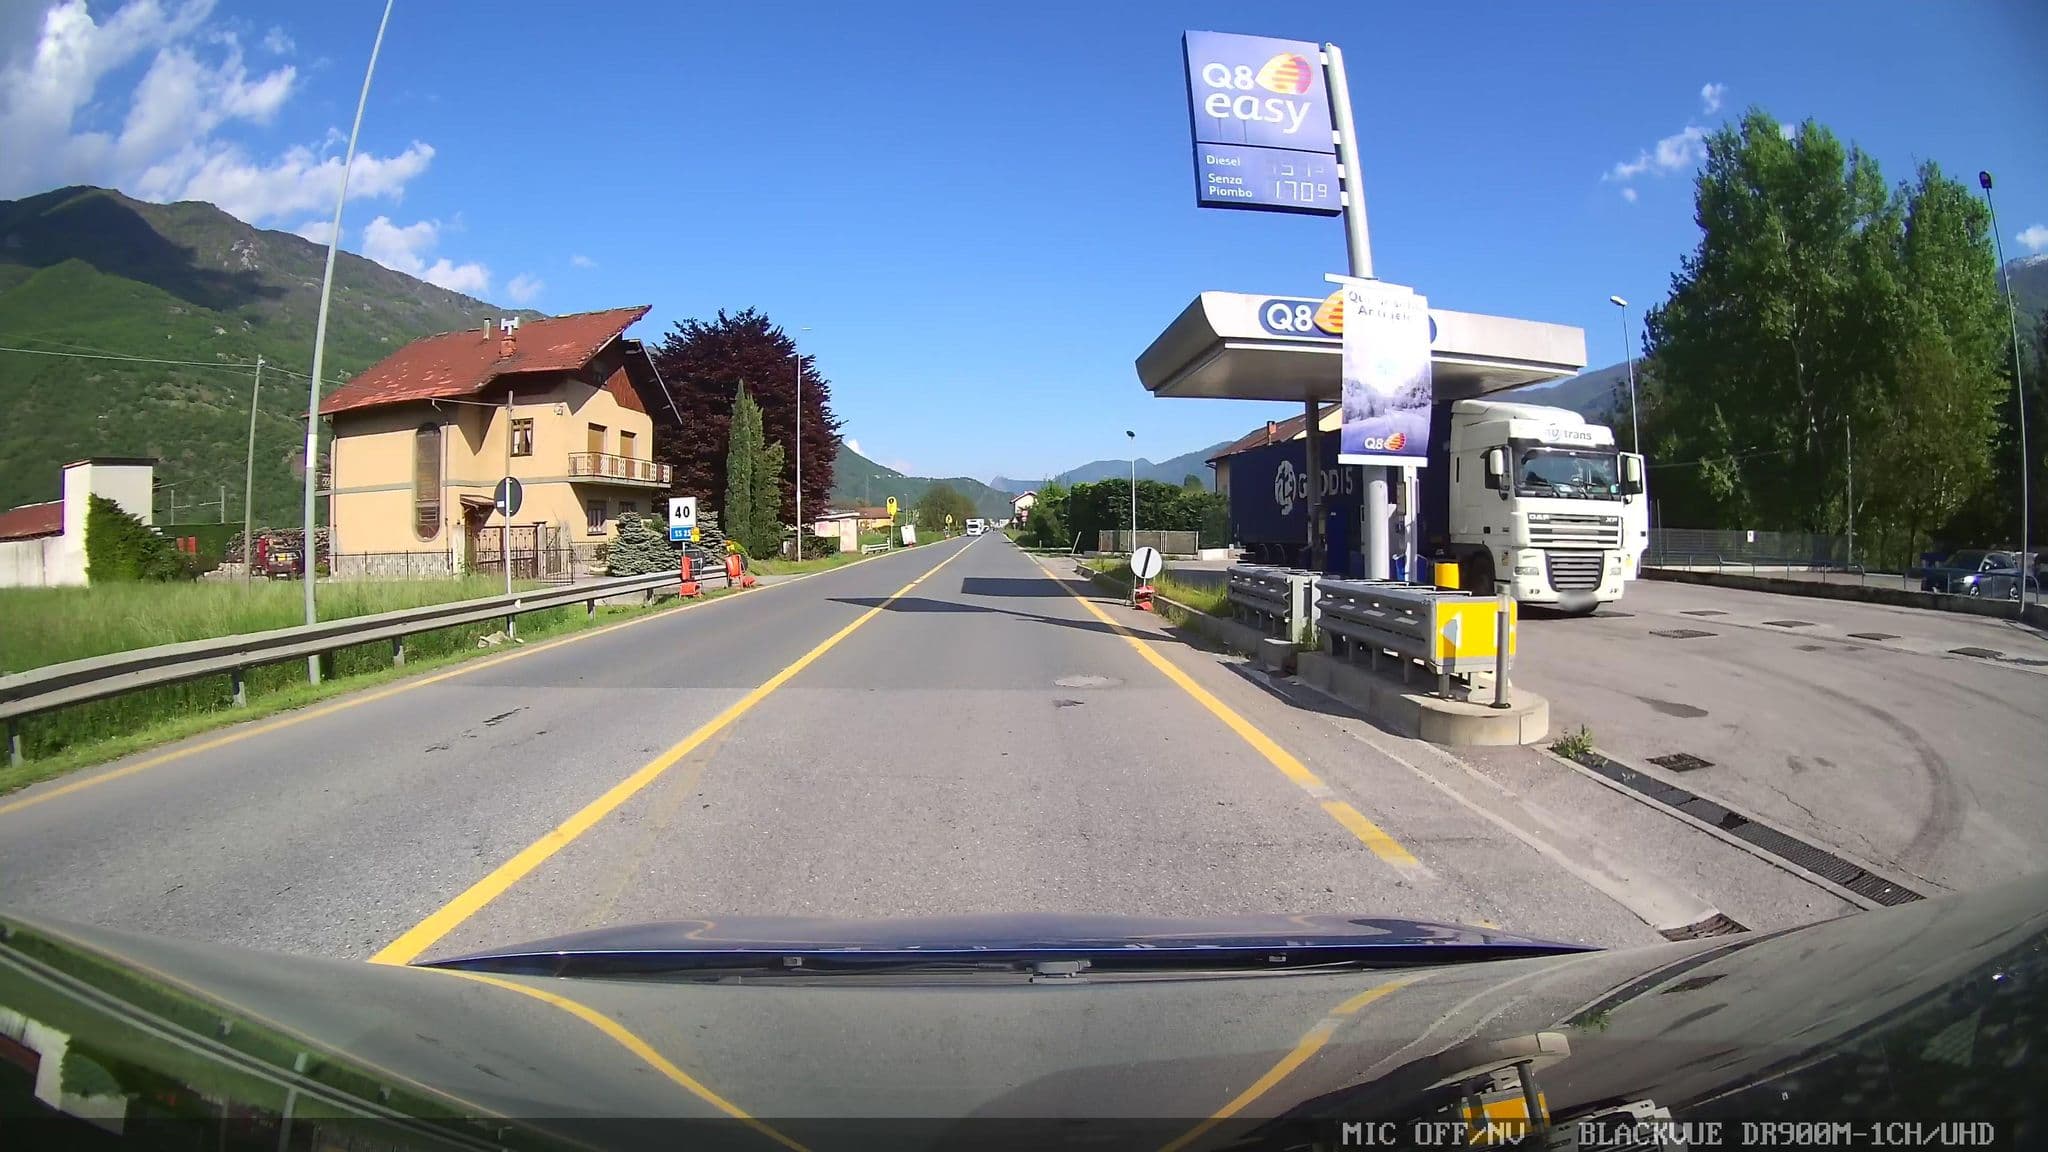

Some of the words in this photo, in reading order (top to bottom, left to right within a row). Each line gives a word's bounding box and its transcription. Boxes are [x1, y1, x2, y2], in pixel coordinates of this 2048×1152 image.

[1202, 62, 1255, 90] Q8
[1204, 91, 1312, 134] easy
[1206, 154, 1241, 167] Diesel
[1208, 173, 1243, 186] Senza
[1209, 186, 1253, 199] Piombo
[1266, 303, 1314, 332] Q8
[1564, 429, 1592, 441] trans
[1364, 436, 1384, 449] Q8
[675, 506, 690, 518] 40
